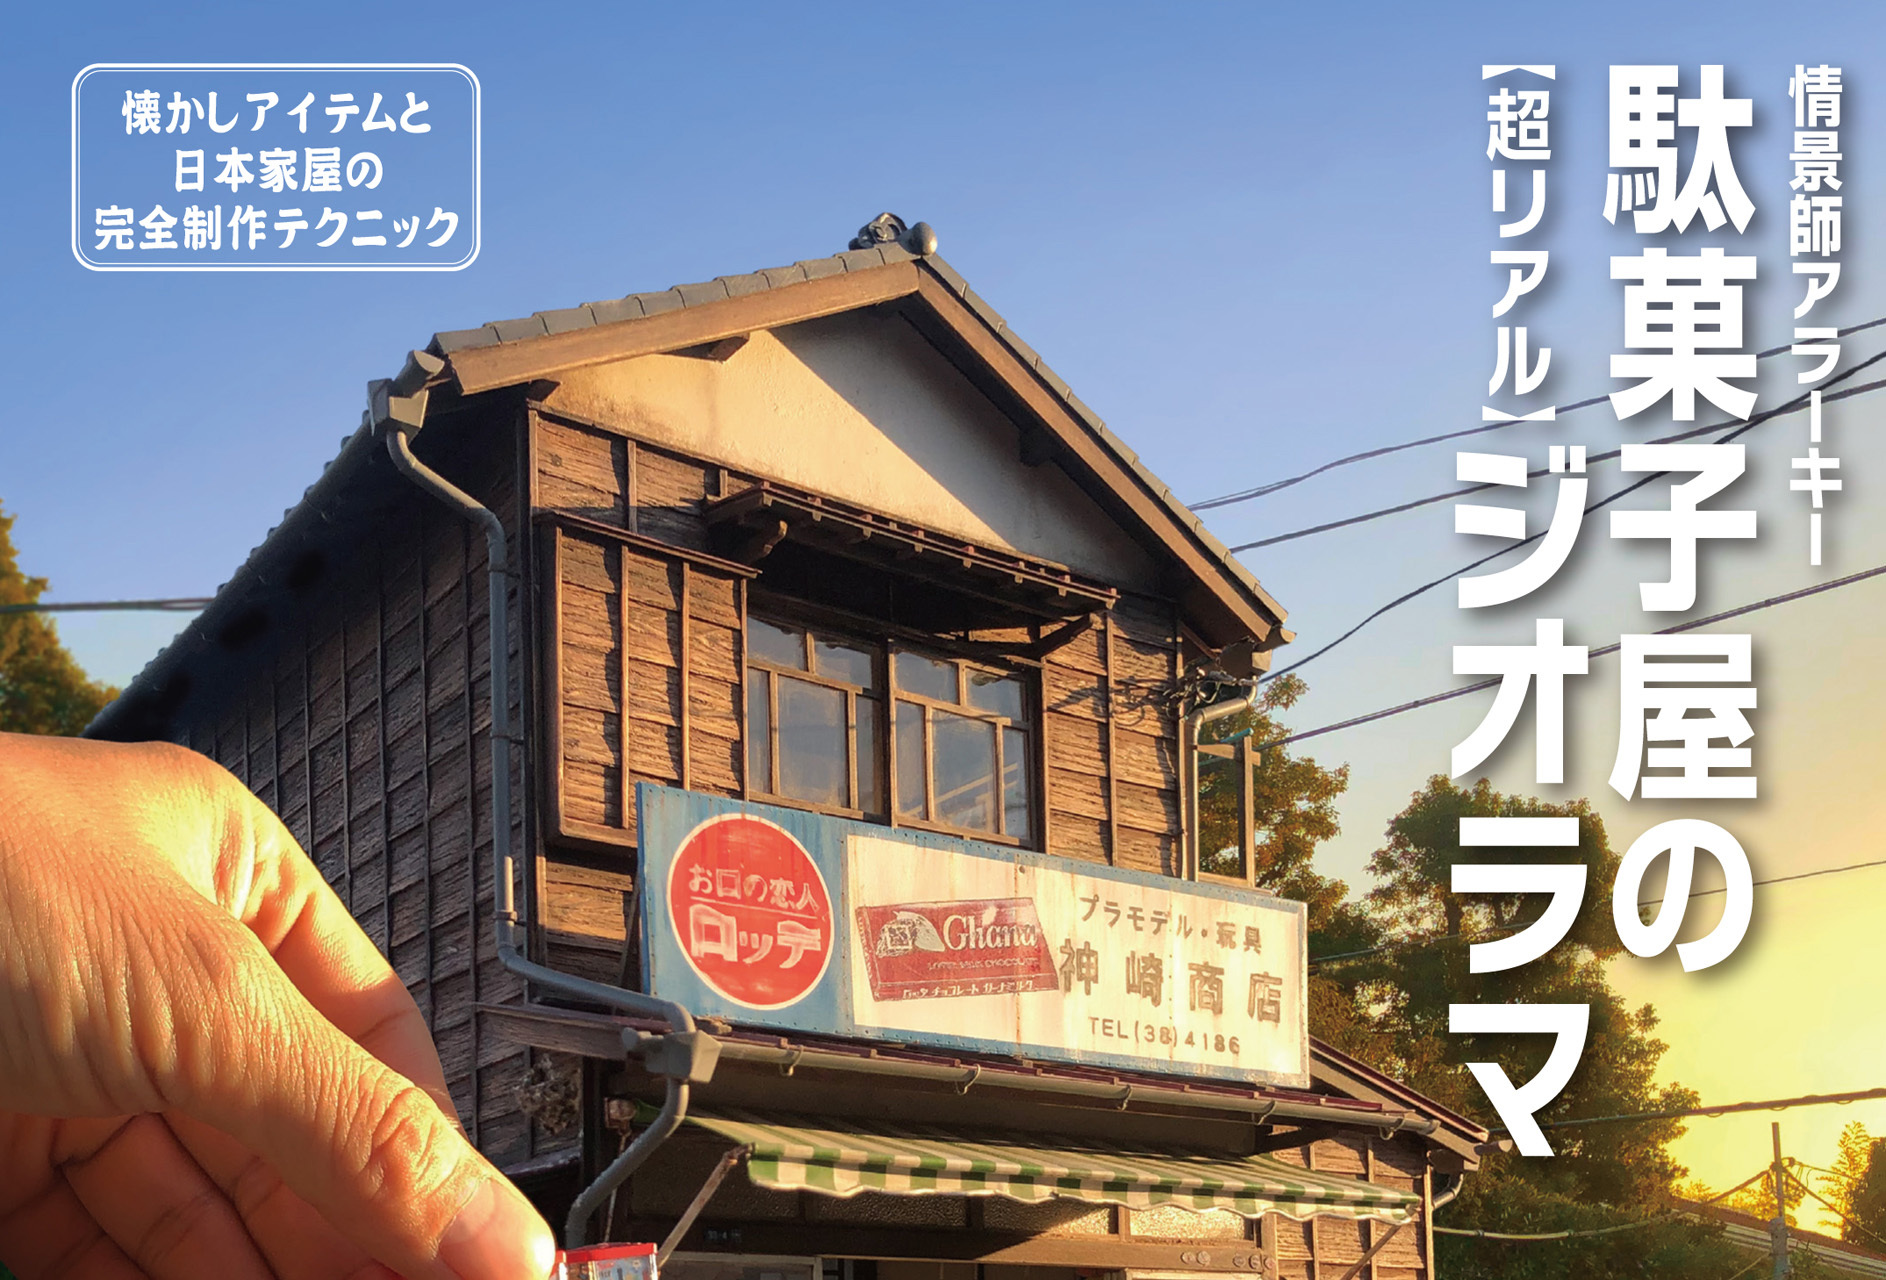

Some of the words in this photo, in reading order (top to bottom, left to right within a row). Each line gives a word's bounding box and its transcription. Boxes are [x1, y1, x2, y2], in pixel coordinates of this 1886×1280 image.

[687, 863, 820, 914] お口の恋人
[689, 903, 822, 970] ロッテ
[943, 913, 1039, 951] Ghana
[1079, 894, 1263, 955] プラモデル・玩具
